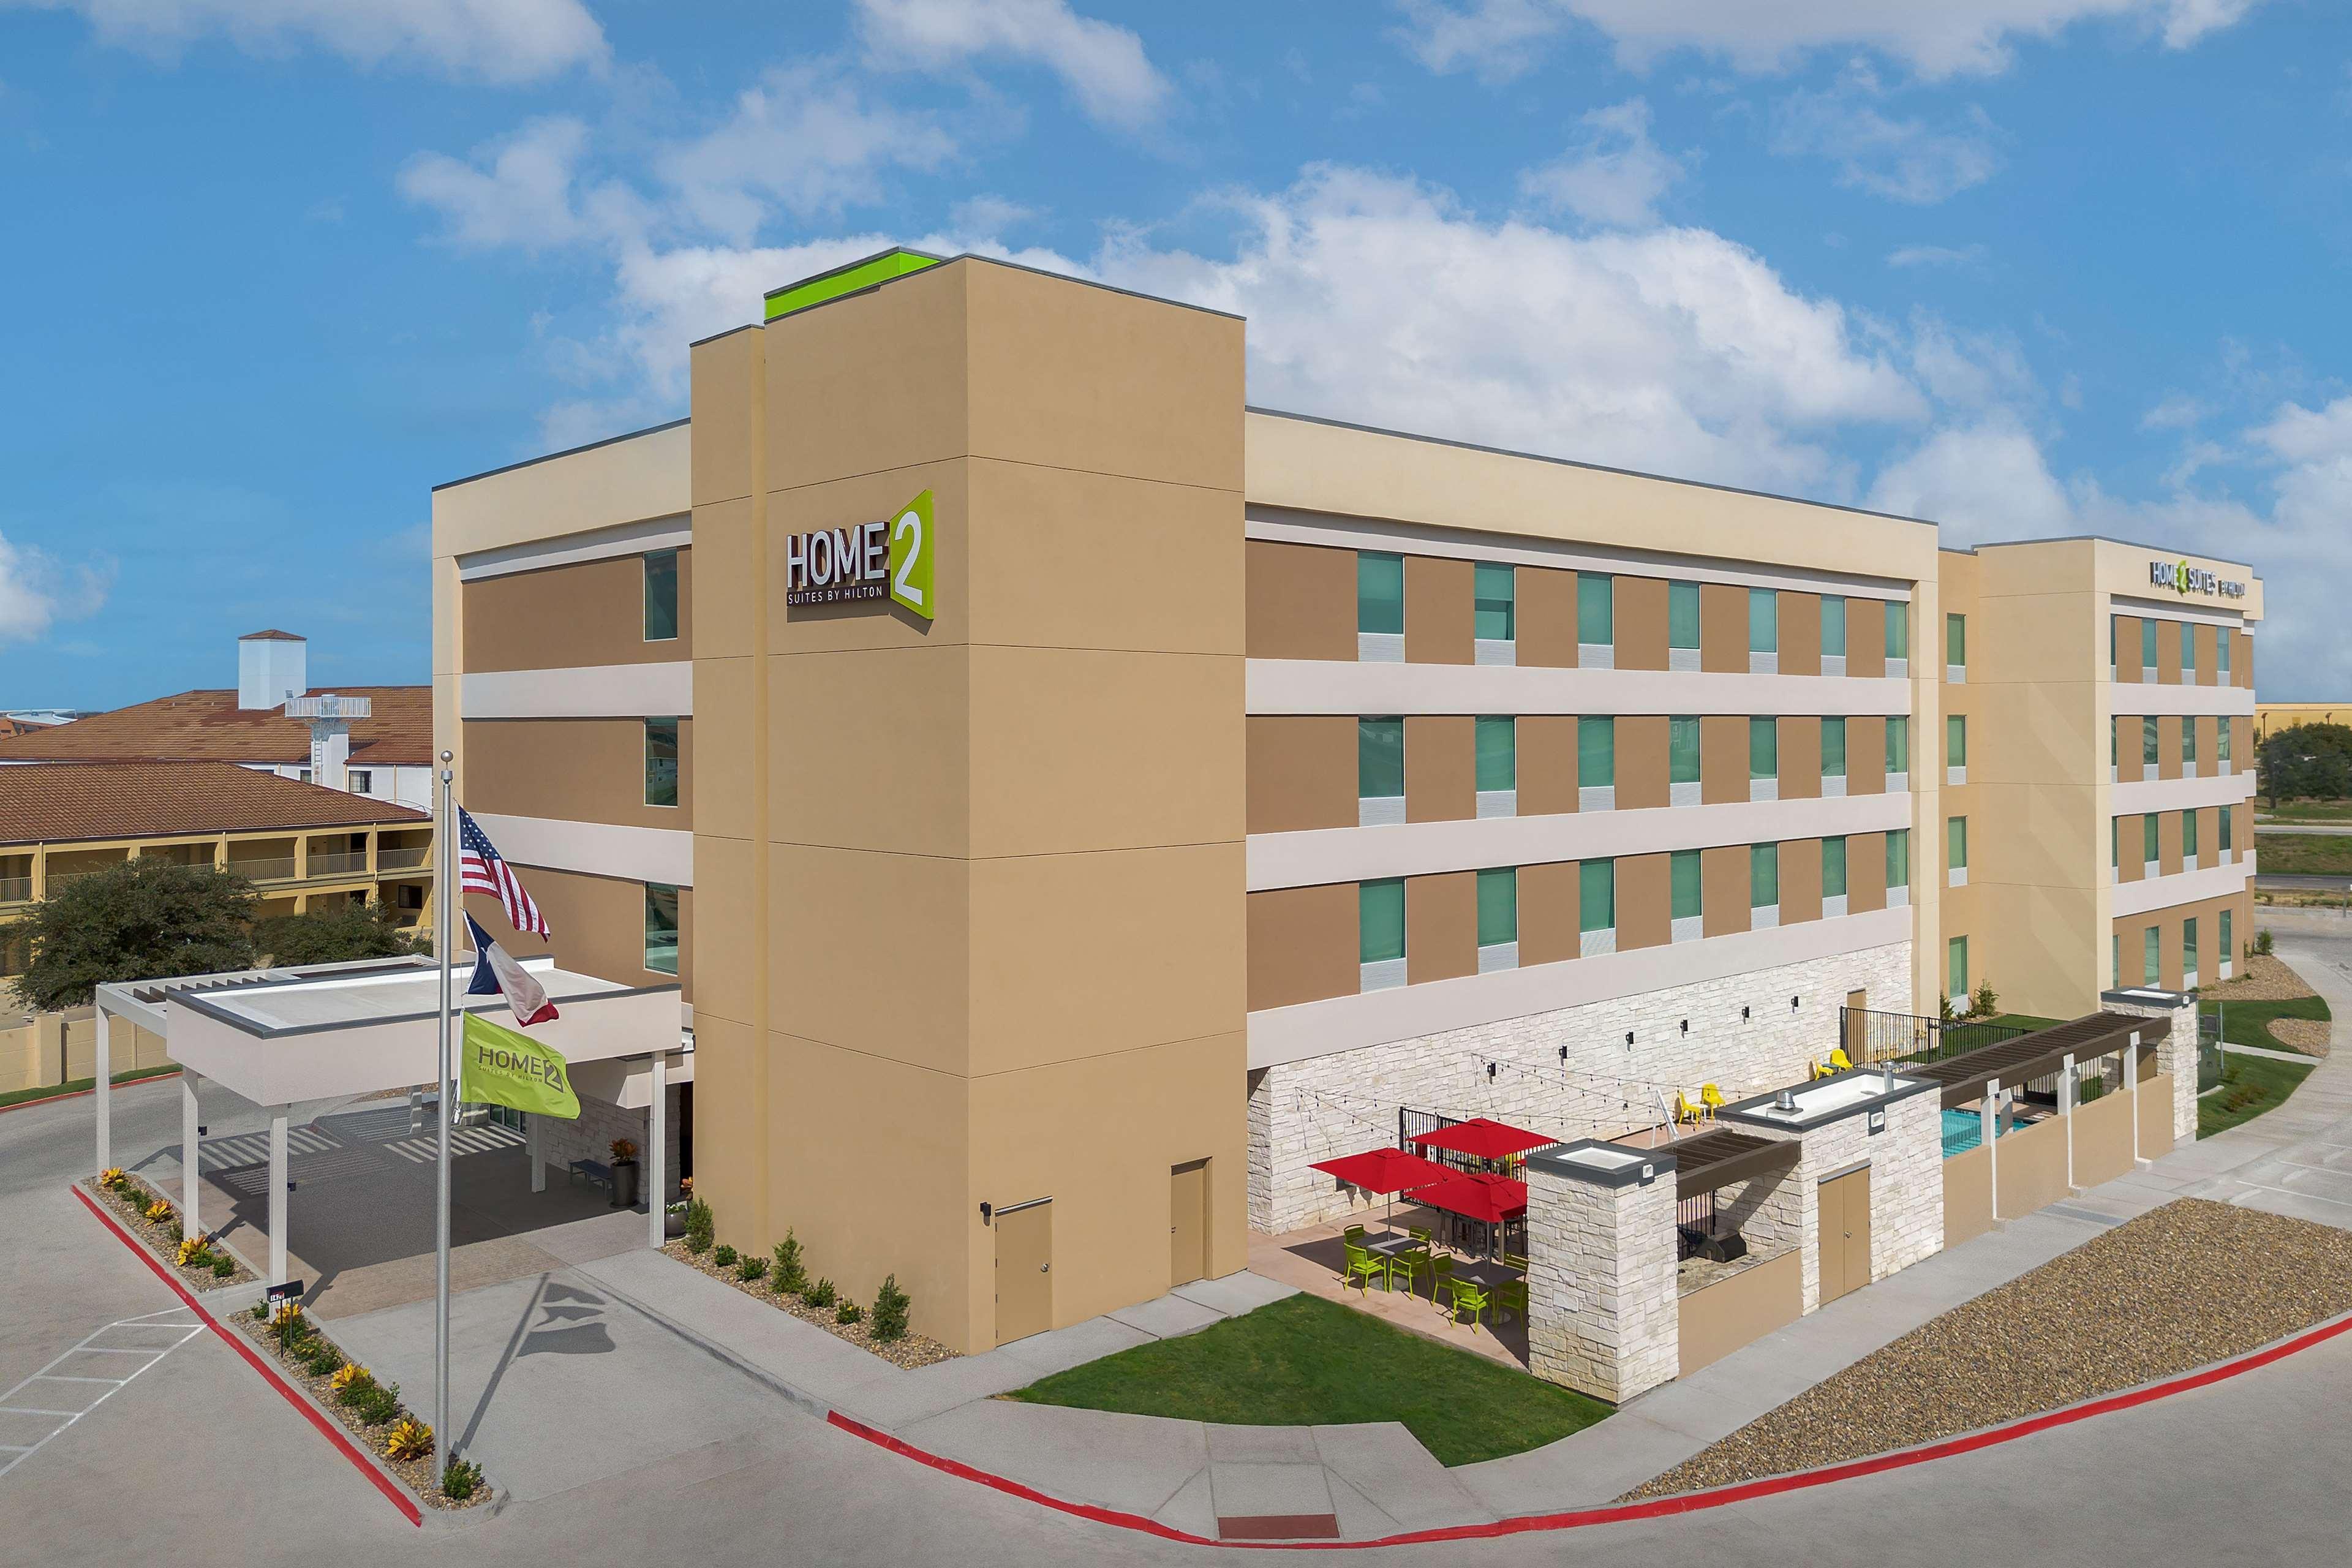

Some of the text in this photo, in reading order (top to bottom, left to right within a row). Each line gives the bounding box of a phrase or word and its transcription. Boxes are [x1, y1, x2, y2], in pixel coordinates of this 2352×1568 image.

[786, 510, 922, 606] HOME 2
[2152, 562, 2179, 586] HOME
[2188, 568, 2216, 592] SUITES
[788, 586, 883, 604] SUITES BY HILTON
[478, 1046, 543, 1076] HOME
[518, 1074, 543, 1083] HILTON
